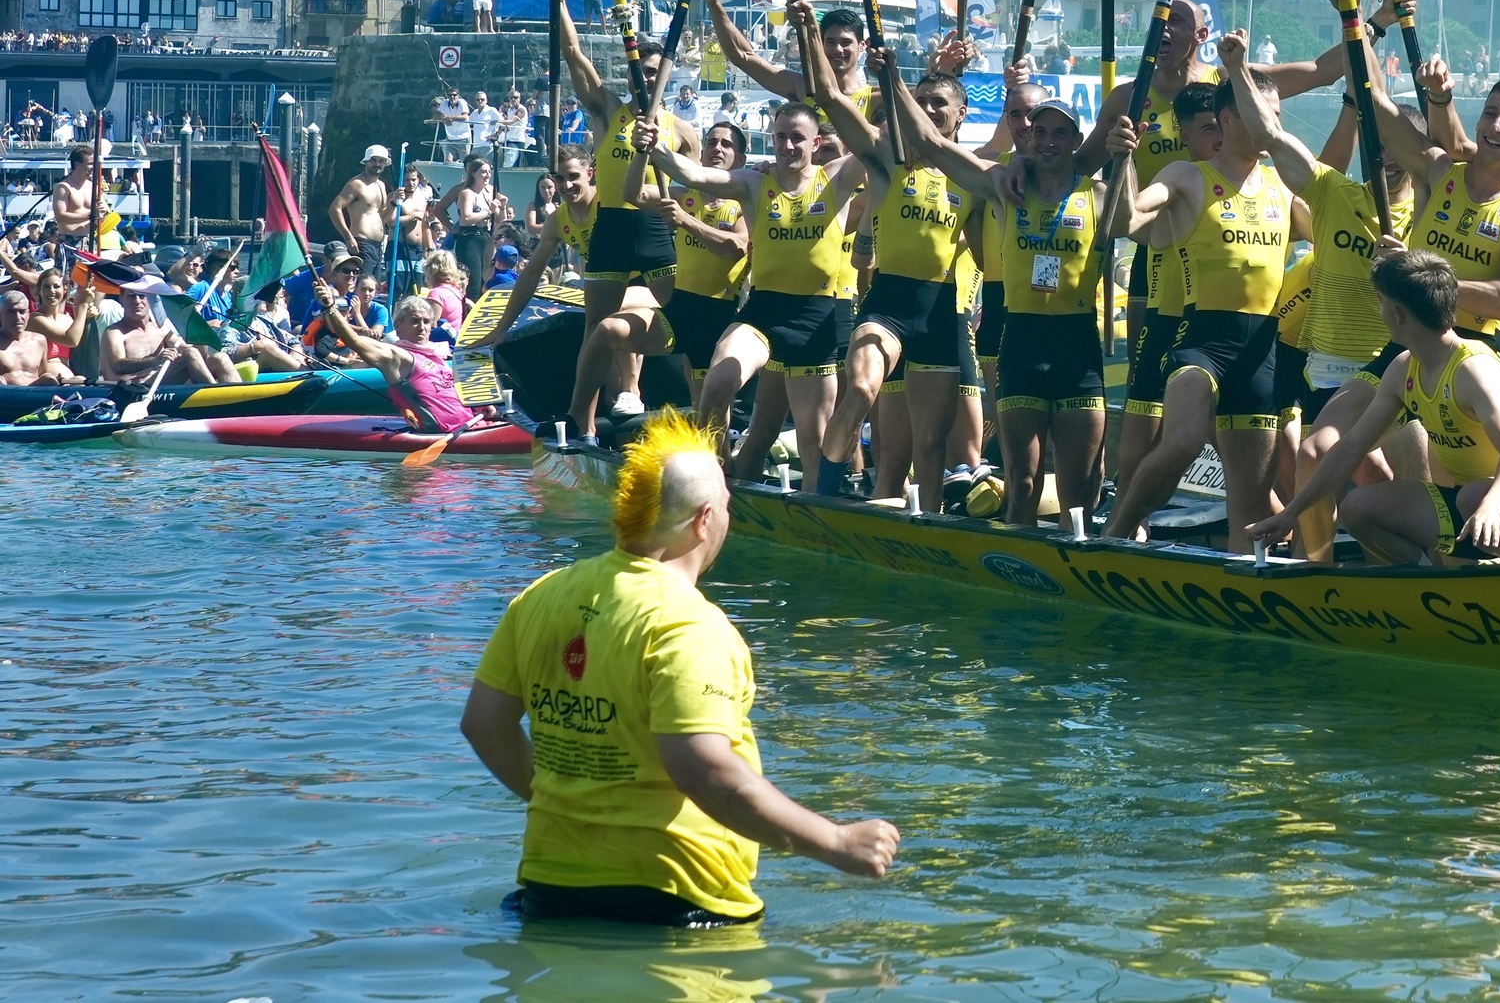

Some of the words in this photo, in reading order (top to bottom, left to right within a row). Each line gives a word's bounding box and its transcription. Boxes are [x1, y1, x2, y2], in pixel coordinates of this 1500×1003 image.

[900, 204, 956, 228] ORIALKI
[768, 225, 824, 240] ORIALKI
[1017, 236, 1083, 253] ORIALKI
[1222, 229, 1281, 246] ORIALKI
[1426, 229, 1491, 266] ORIALKI
[1150, 264, 1161, 299] Loiola
[1182, 259, 1192, 296] Loiola
[1278, 294, 1305, 320] Loiol
[1427, 430, 1476, 448] RIALKI
[991, 558, 1053, 592] Ford
